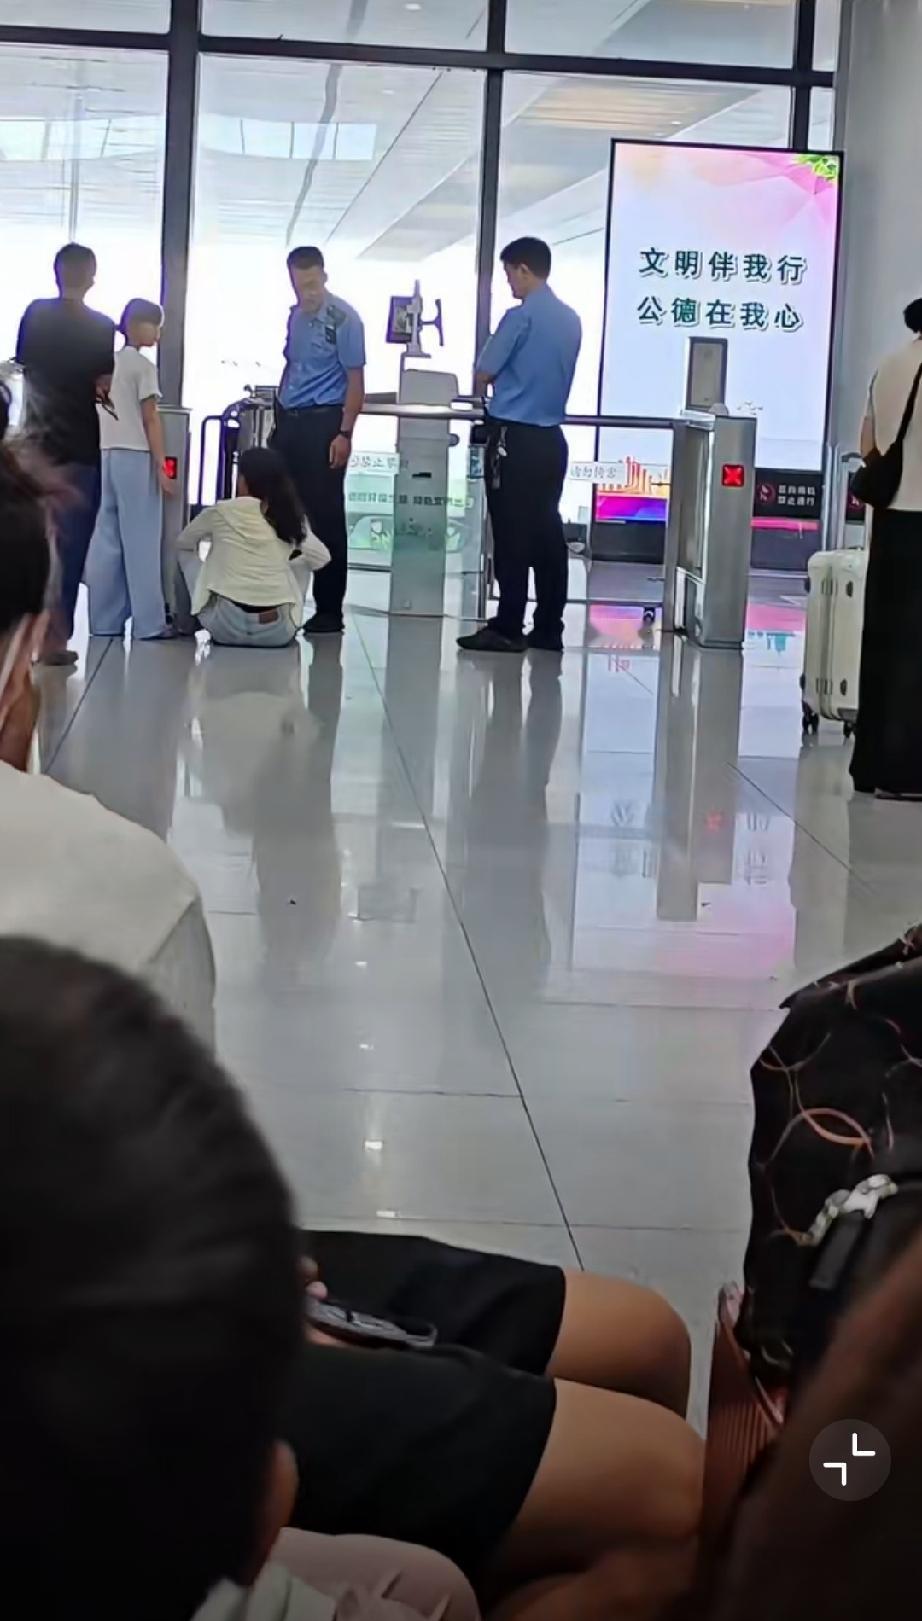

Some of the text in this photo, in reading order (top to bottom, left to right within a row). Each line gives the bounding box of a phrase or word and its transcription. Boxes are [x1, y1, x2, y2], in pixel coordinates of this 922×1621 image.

[638, 246, 807, 285] 文明伴我行
[637, 295, 804, 333] 公德在我心
